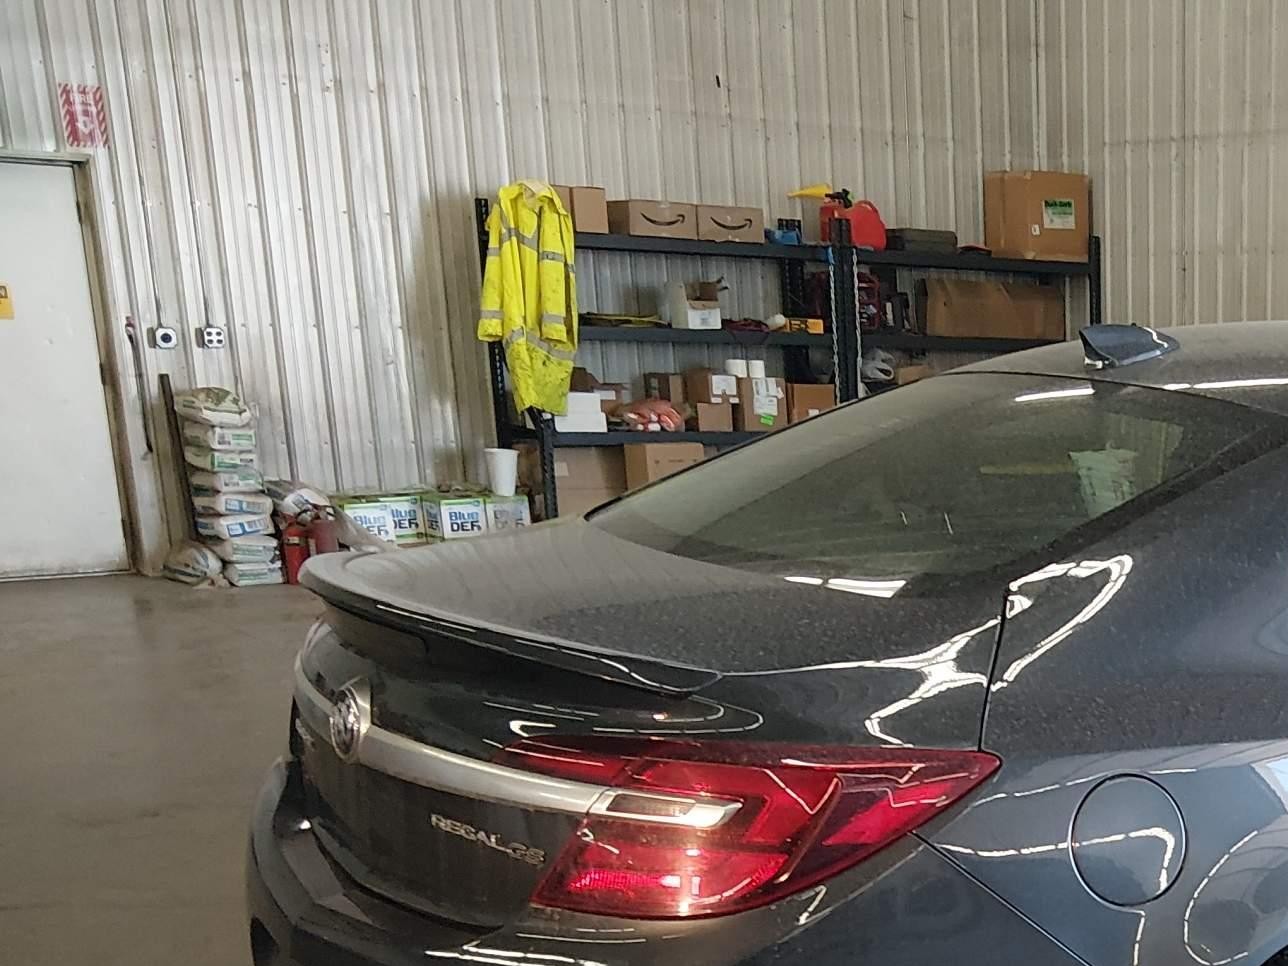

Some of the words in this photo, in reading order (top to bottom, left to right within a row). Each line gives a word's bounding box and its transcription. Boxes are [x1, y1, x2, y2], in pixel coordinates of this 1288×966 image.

[449, 511, 479, 521] Blue
[450, 520, 482, 532] DEF
[431, 813, 513, 853] REGAL
[509, 842, 546, 867] GS
